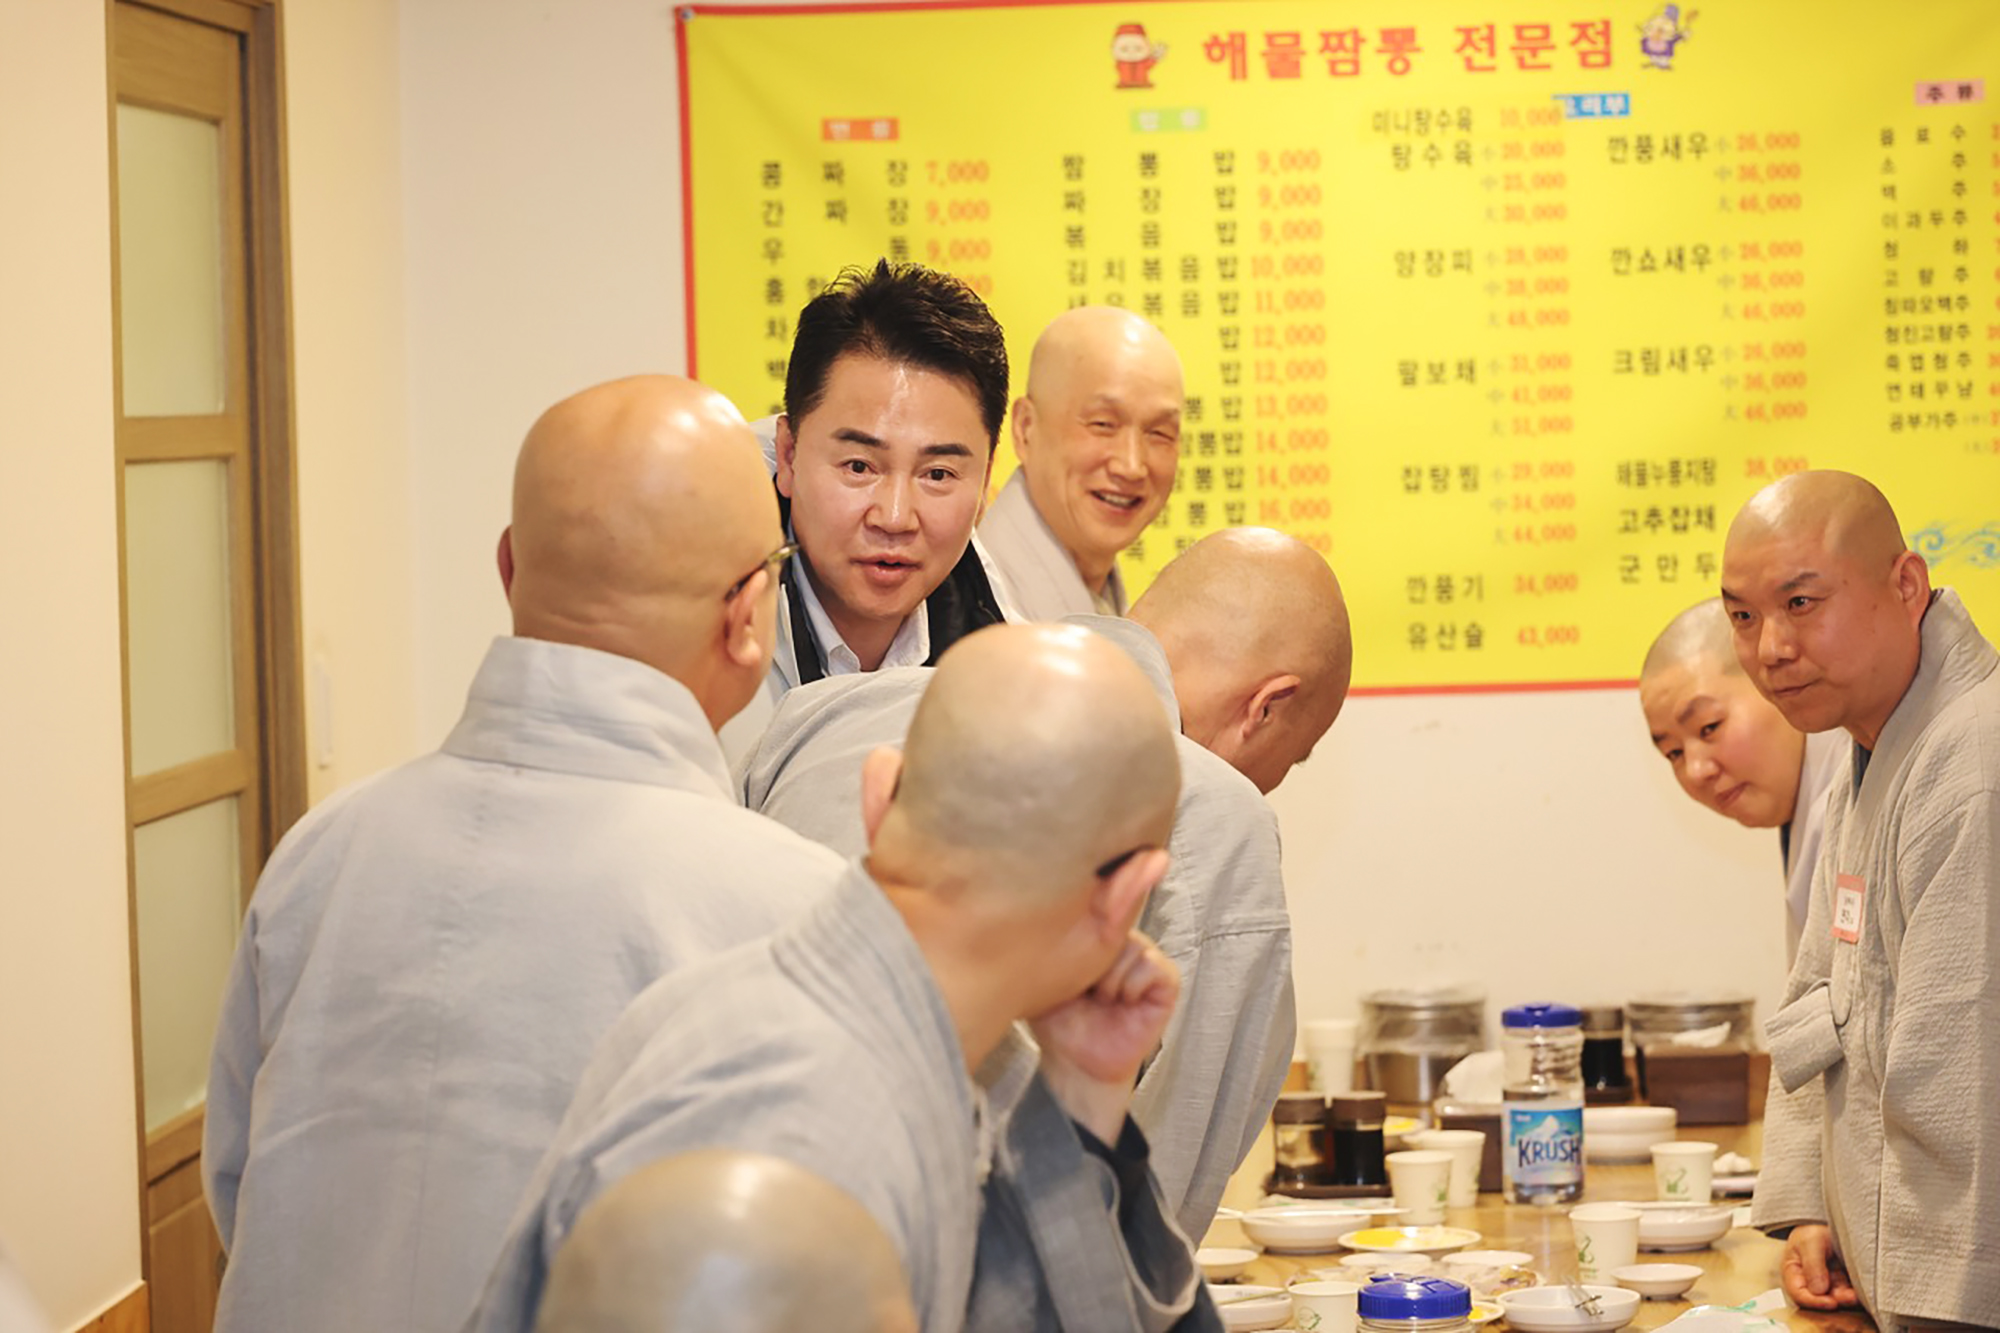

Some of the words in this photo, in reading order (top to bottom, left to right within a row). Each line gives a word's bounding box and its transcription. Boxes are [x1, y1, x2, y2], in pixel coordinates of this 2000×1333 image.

[1201, 26, 1422, 81] 해물짬뽕
[1455, 18, 1613, 72] 전문점
[1373, 106, 1473, 137] 미니탕수육
[1391, 139, 1472, 171] 탕수육
[1609, 132, 1708, 163] 깐풍새우
[925, 159, 990, 187] 7,000
[1062, 152, 1234, 181] 짬뽕밥
[1257, 149, 1321, 176] 9,000
[763, 197, 909, 228] 간짜장
[925, 199, 990, 226] 9,000
[1063, 186, 1236, 214] 짜장밥
[1258, 183, 1322, 211] 9,000
[1064, 221, 1237, 250] 볶음밥
[1259, 219, 1324, 246] 9,000
[926, 238, 991, 265] 9,000
[1394, 249, 1472, 278] 양장피
[1068, 256, 1238, 286] 김치볶음밥
[1251, 254, 1324, 281] 10,000
[1256, 289, 1325, 316] 11,000
[1399, 359, 1476, 387] 팔보채
[1615, 345, 1714, 375] 크림새우
[1618, 458, 1717, 488] 해물누룽지탕
[1620, 505, 1715, 533] 고추잡채
[1619, 552, 1716, 584] 군만두
[1408, 575, 1483, 604] 깐풍기
[1409, 622, 1484, 650] 유산슬
[1518, 1138, 1580, 1168] KRUSH
